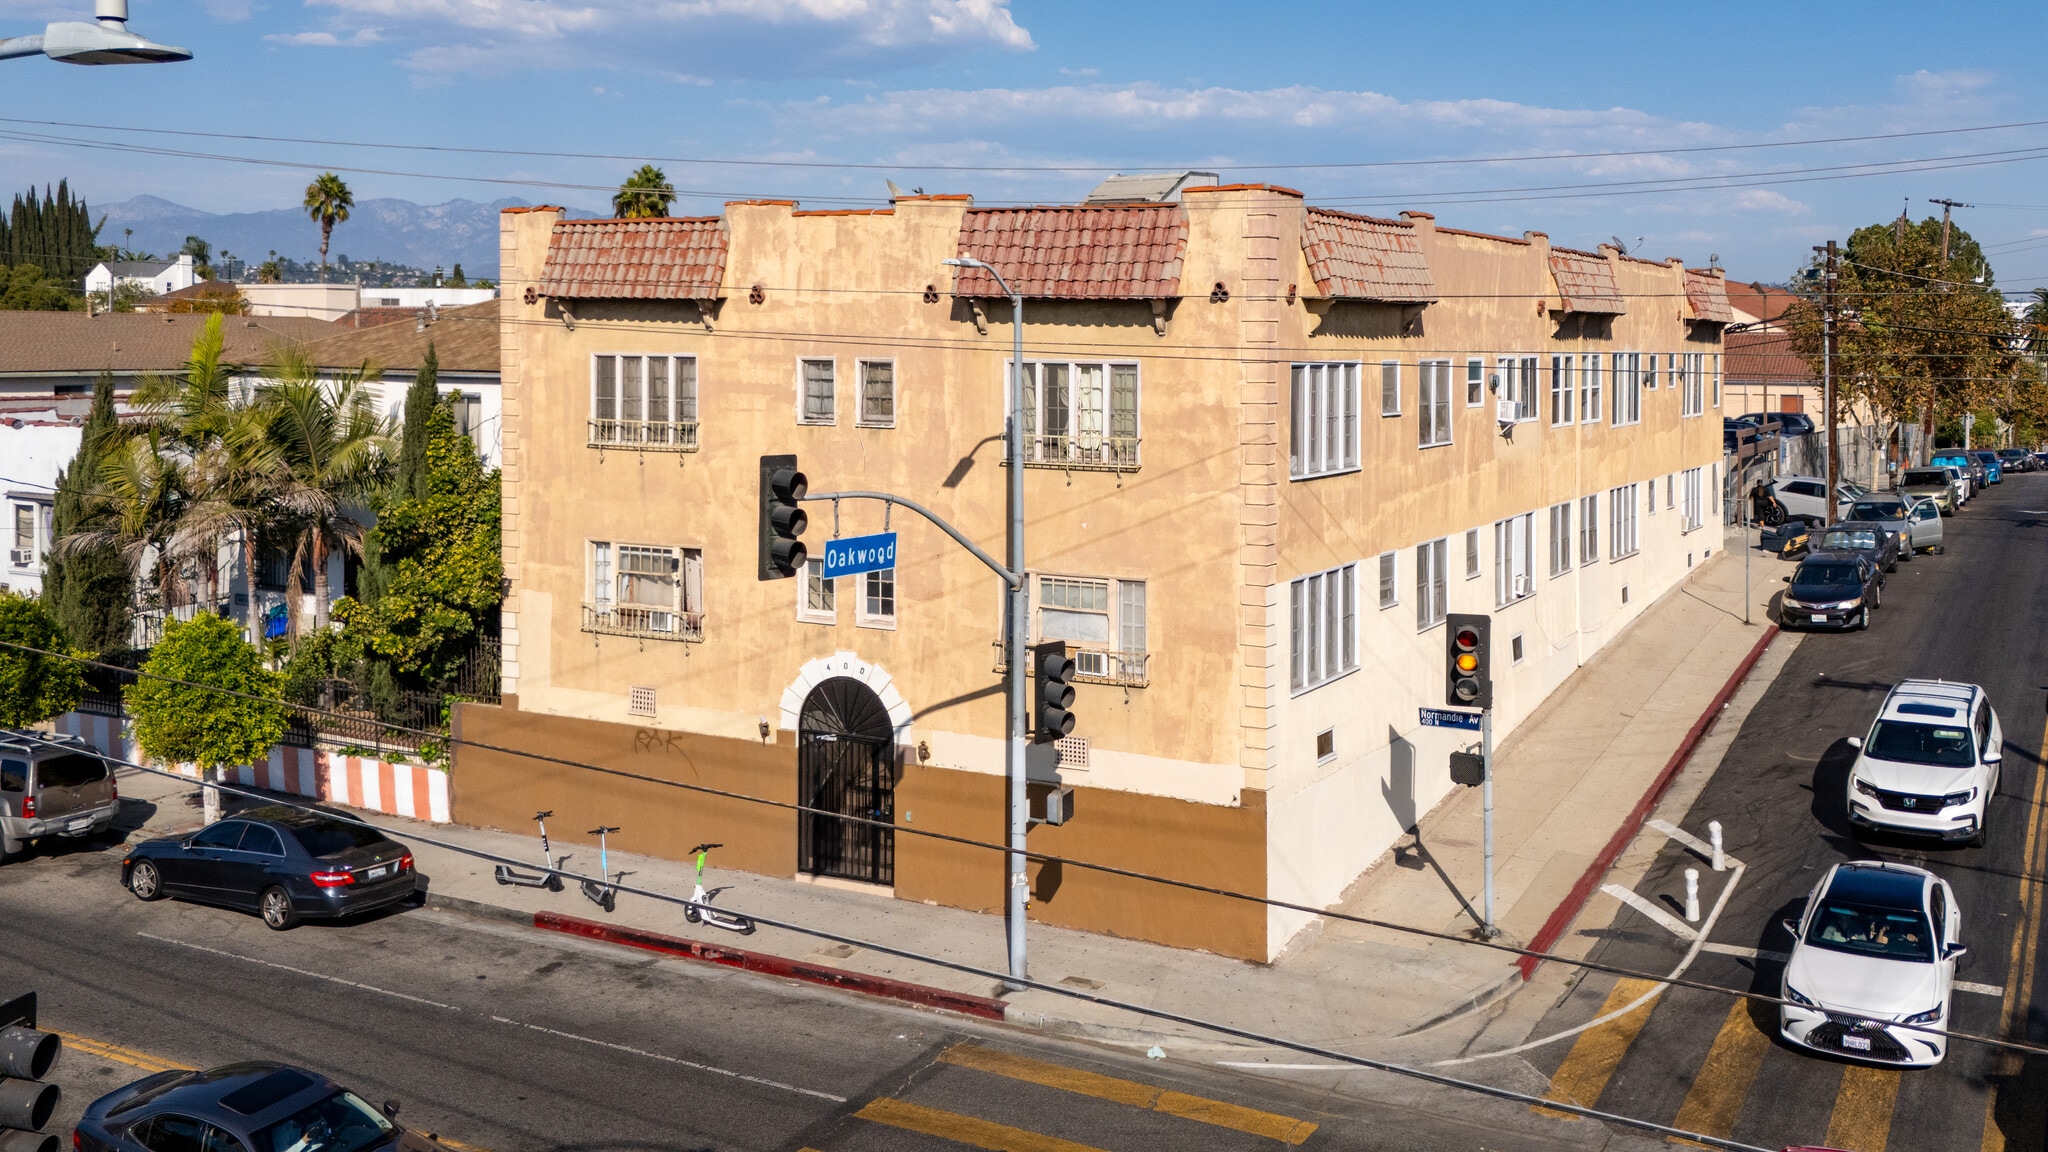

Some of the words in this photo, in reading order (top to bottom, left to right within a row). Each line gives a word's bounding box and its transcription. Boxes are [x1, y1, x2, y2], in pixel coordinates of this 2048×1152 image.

[827, 541, 894, 569] Oakwood
[826, 662, 865, 675] 400
[1421, 709, 1463, 723] Normandie
[1469, 714, 1479, 724] Av
